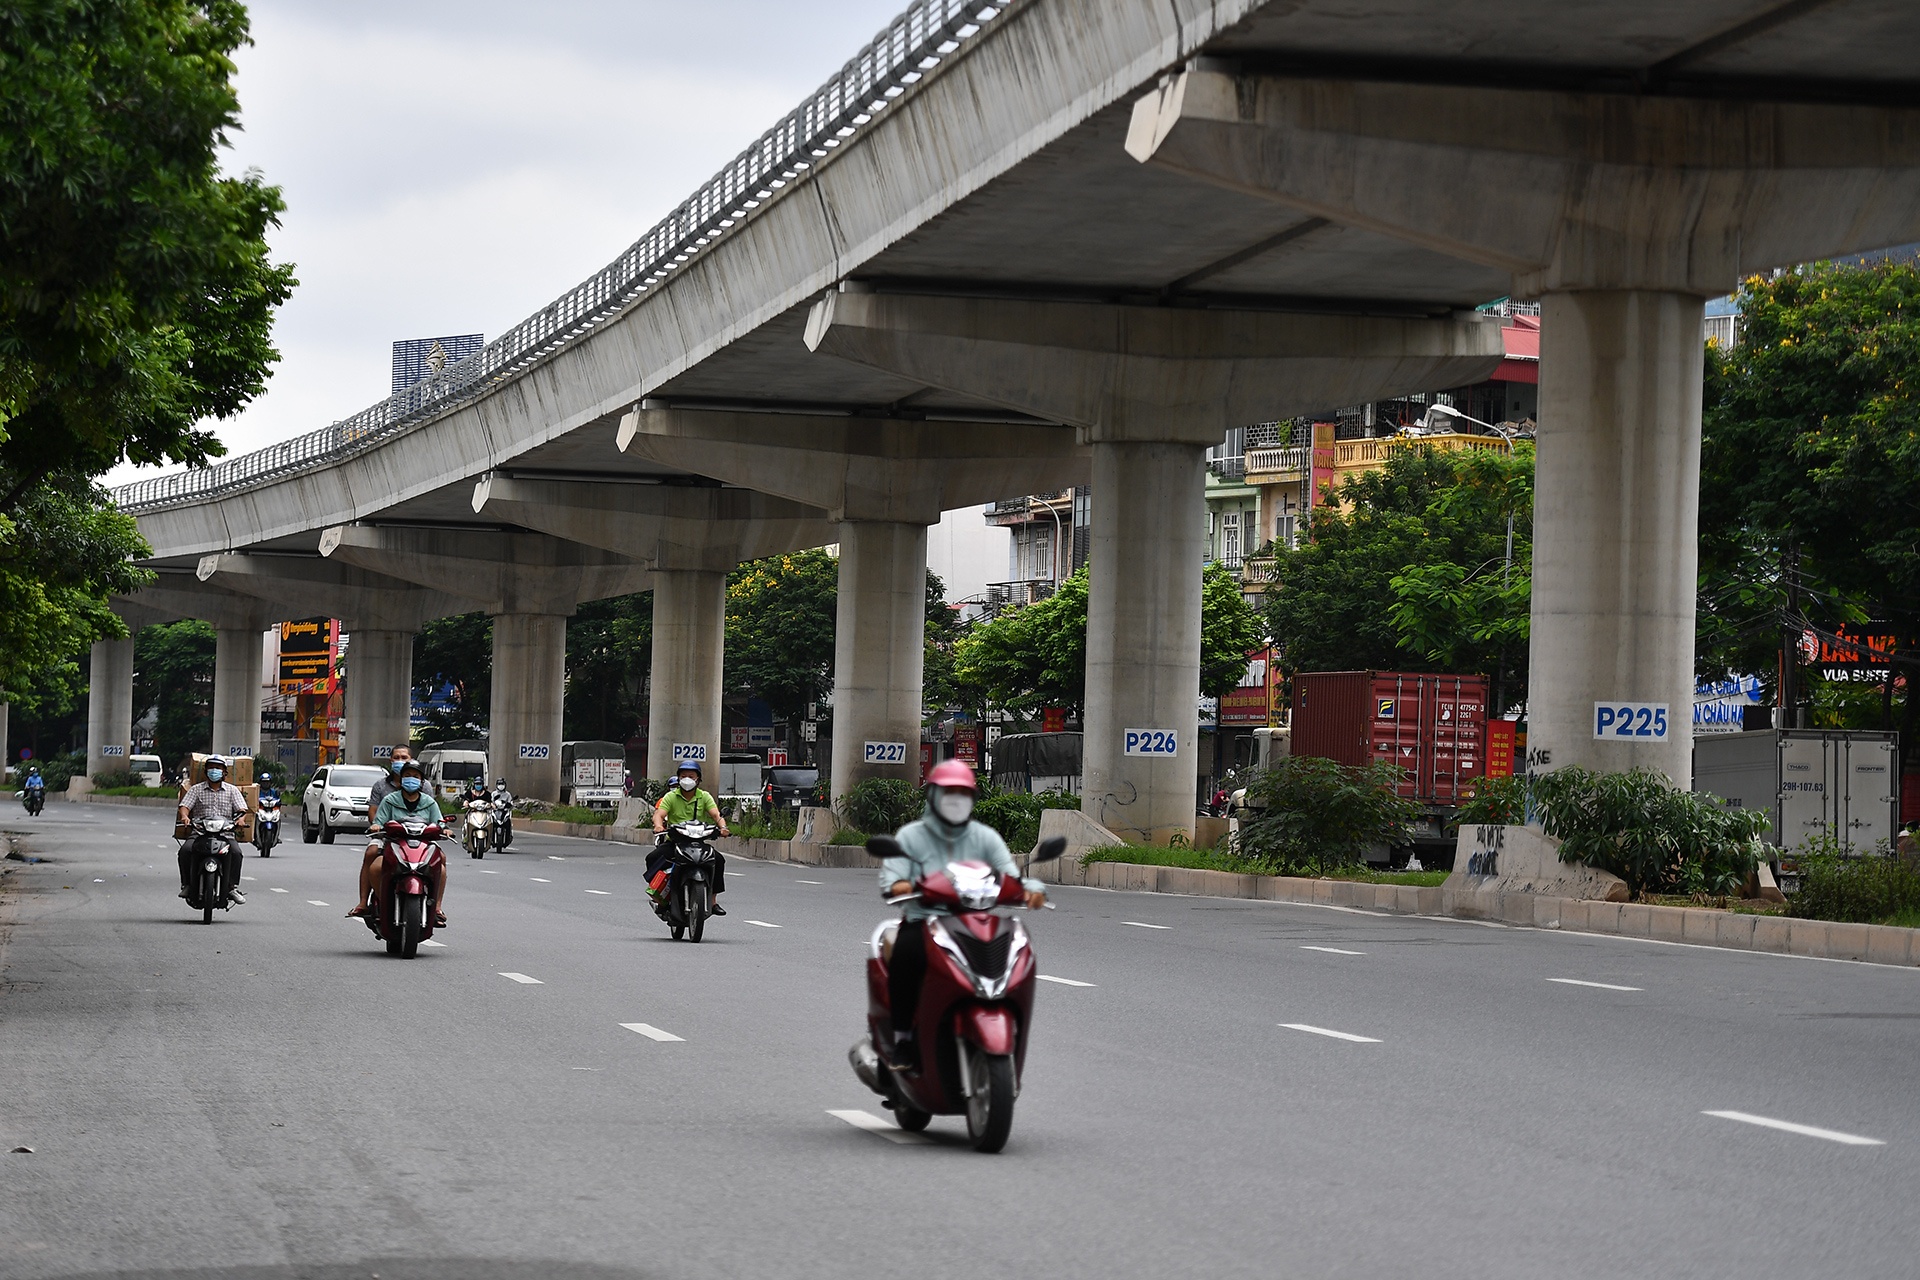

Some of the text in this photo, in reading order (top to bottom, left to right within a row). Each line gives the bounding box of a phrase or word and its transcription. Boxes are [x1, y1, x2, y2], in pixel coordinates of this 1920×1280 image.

[1823, 669, 1890, 682] VUA BUFFE
[1704, 700, 1728, 722] CHÂU
[1731, 704, 1743, 728] HẠ
[1597, 707, 1667, 737] P225
[1126, 732, 1176, 753] P226
[104, 746, 123, 755] P232
[231, 746, 251, 756] P231
[373, 747, 391, 757] P23
[520, 746, 548, 757] P229
[674, 746, 705, 759] P228
[866, 744, 905, 760] P227
[769, 753, 787, 766] in
[1782, 782, 1824, 792] 29H-107.63
